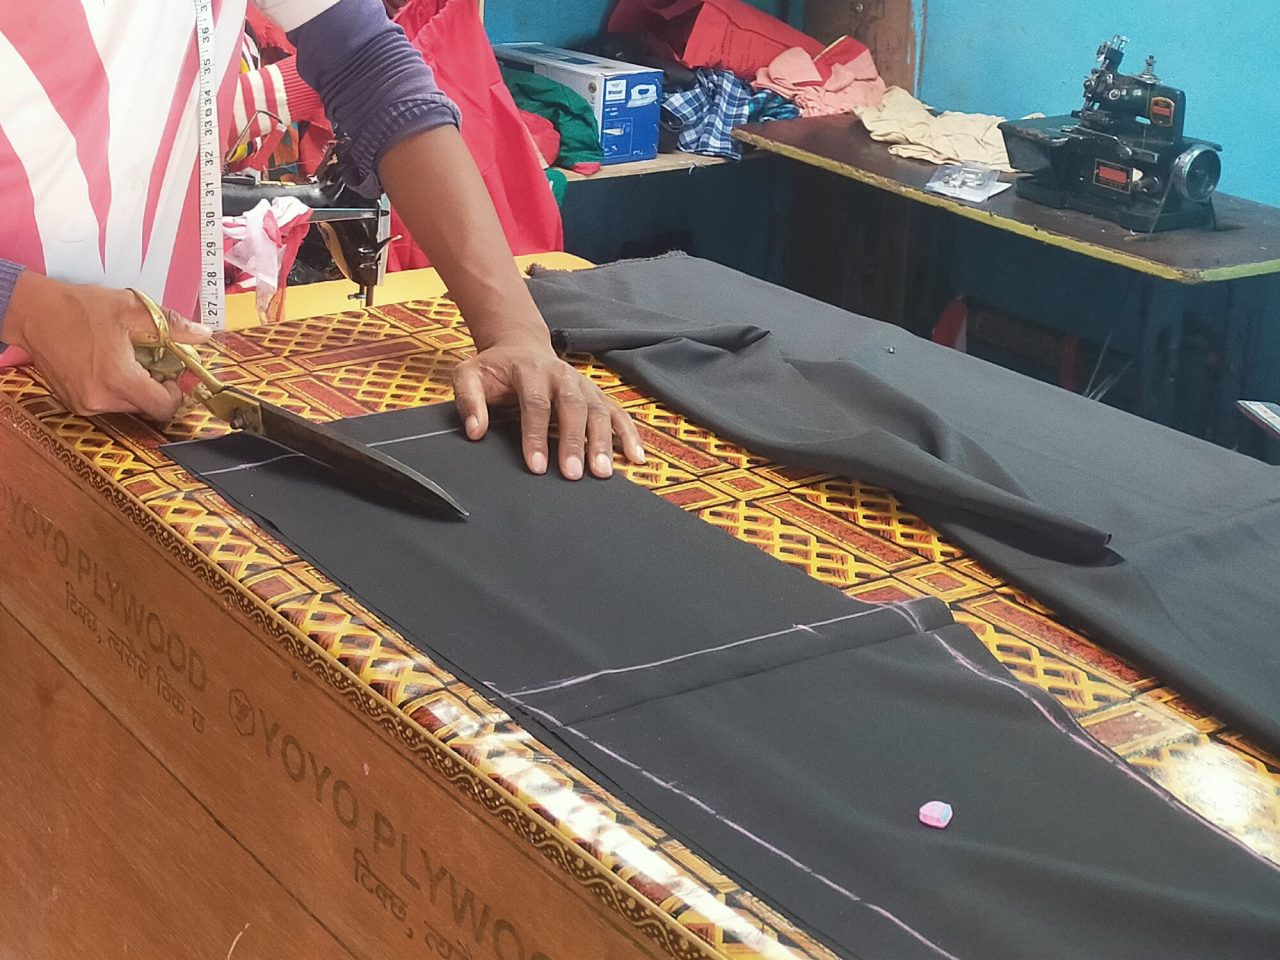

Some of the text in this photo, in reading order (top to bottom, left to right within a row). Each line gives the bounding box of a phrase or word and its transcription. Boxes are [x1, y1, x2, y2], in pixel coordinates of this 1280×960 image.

[202, 26, 210, 44] 36
[203, 58, 211, 75] 35
[204, 90, 212, 106] 34
[204, 120, 213, 136] 33
[205, 150, 214, 166] 32
[206, 181, 215, 197] 31
[206, 211, 216, 227] 30
[206, 241, 217, 257] 29
[207, 271, 217, 287] 28
[208, 301, 218, 316] 27
[5, 486, 207, 692] YOYO PLYWOOD
[257, 709, 552, 960] YOYO PLYWO
